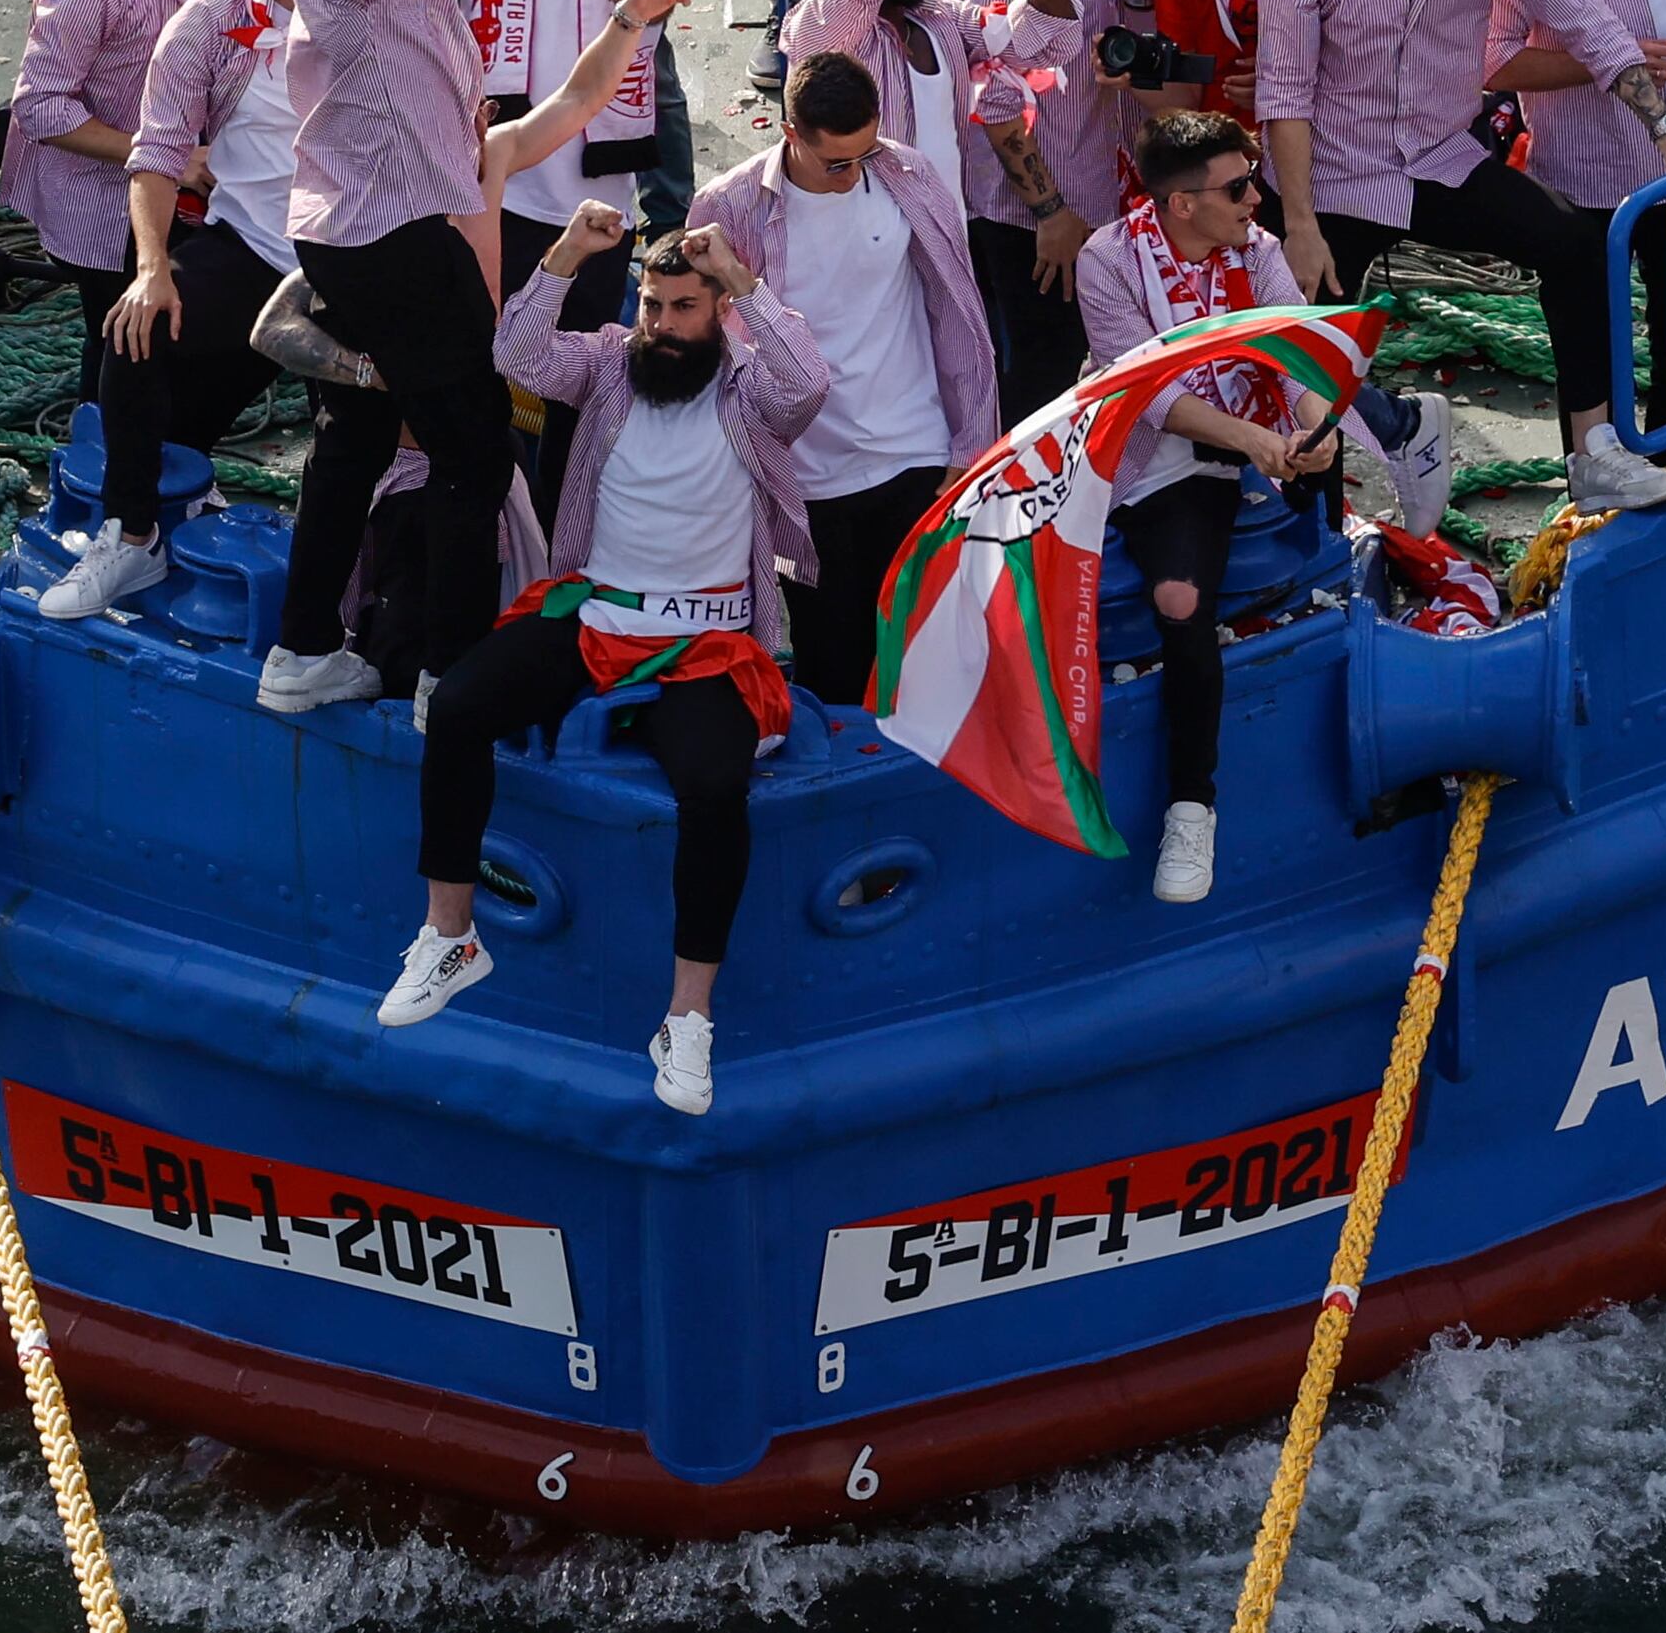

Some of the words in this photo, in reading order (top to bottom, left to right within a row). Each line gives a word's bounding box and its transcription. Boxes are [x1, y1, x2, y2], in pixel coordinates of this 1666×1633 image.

[567, 1341, 598, 1391] 8
[818, 1342, 846, 1394] 8
[537, 1450, 576, 1502] 6
[846, 1444, 880, 1501] 6
